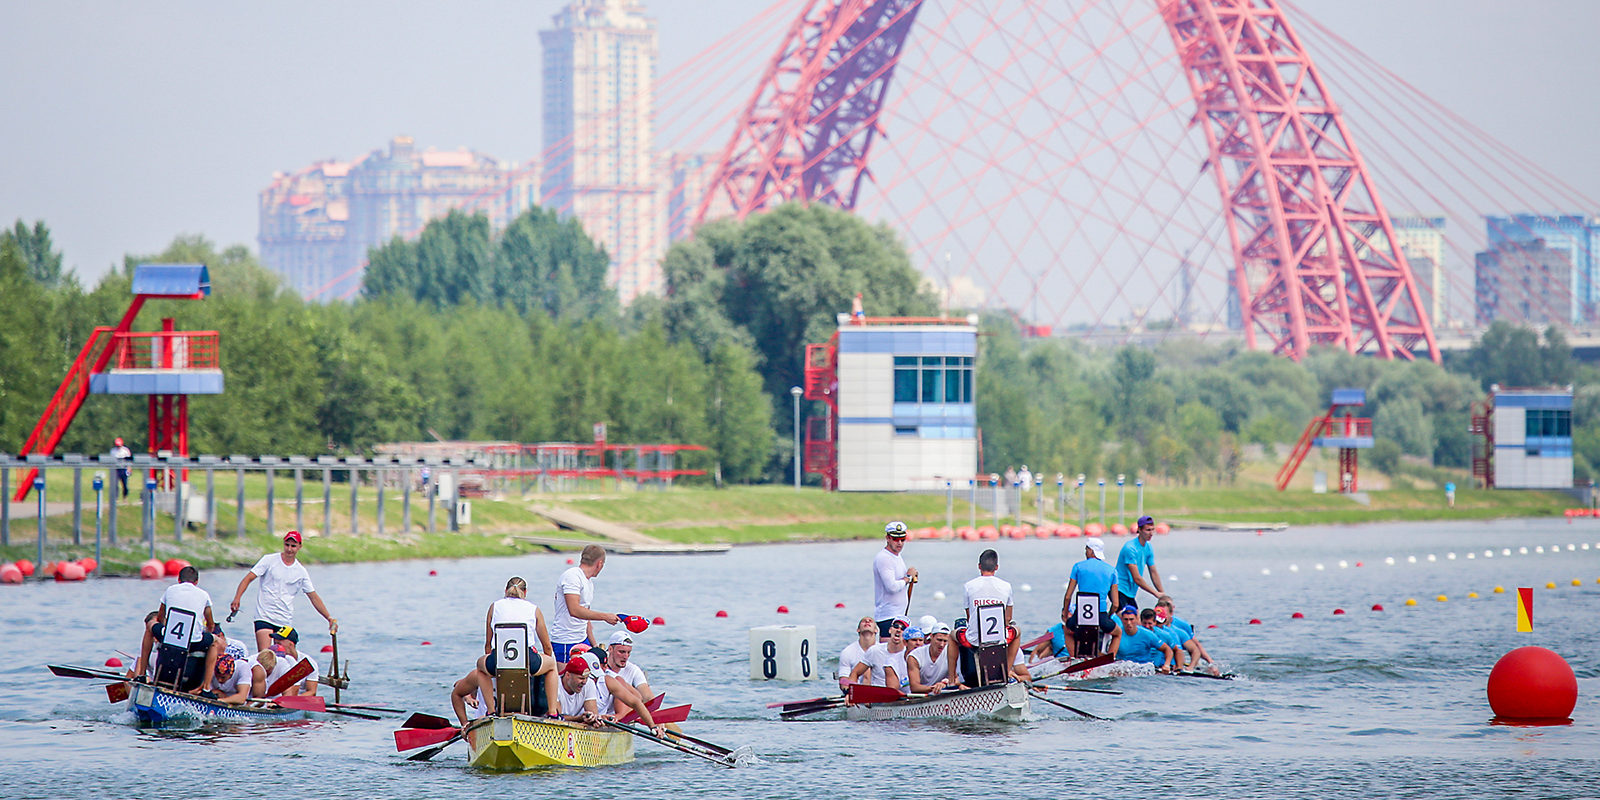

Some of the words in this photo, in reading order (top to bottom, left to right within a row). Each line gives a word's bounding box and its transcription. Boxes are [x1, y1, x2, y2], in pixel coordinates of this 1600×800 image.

[1082, 603, 1094, 620] 8
[170, 621, 185, 640] 4
[985, 616, 999, 636] 2
[503, 639, 519, 661] 6
[762, 640, 777, 680] 8
[800, 639, 811, 678] 8
